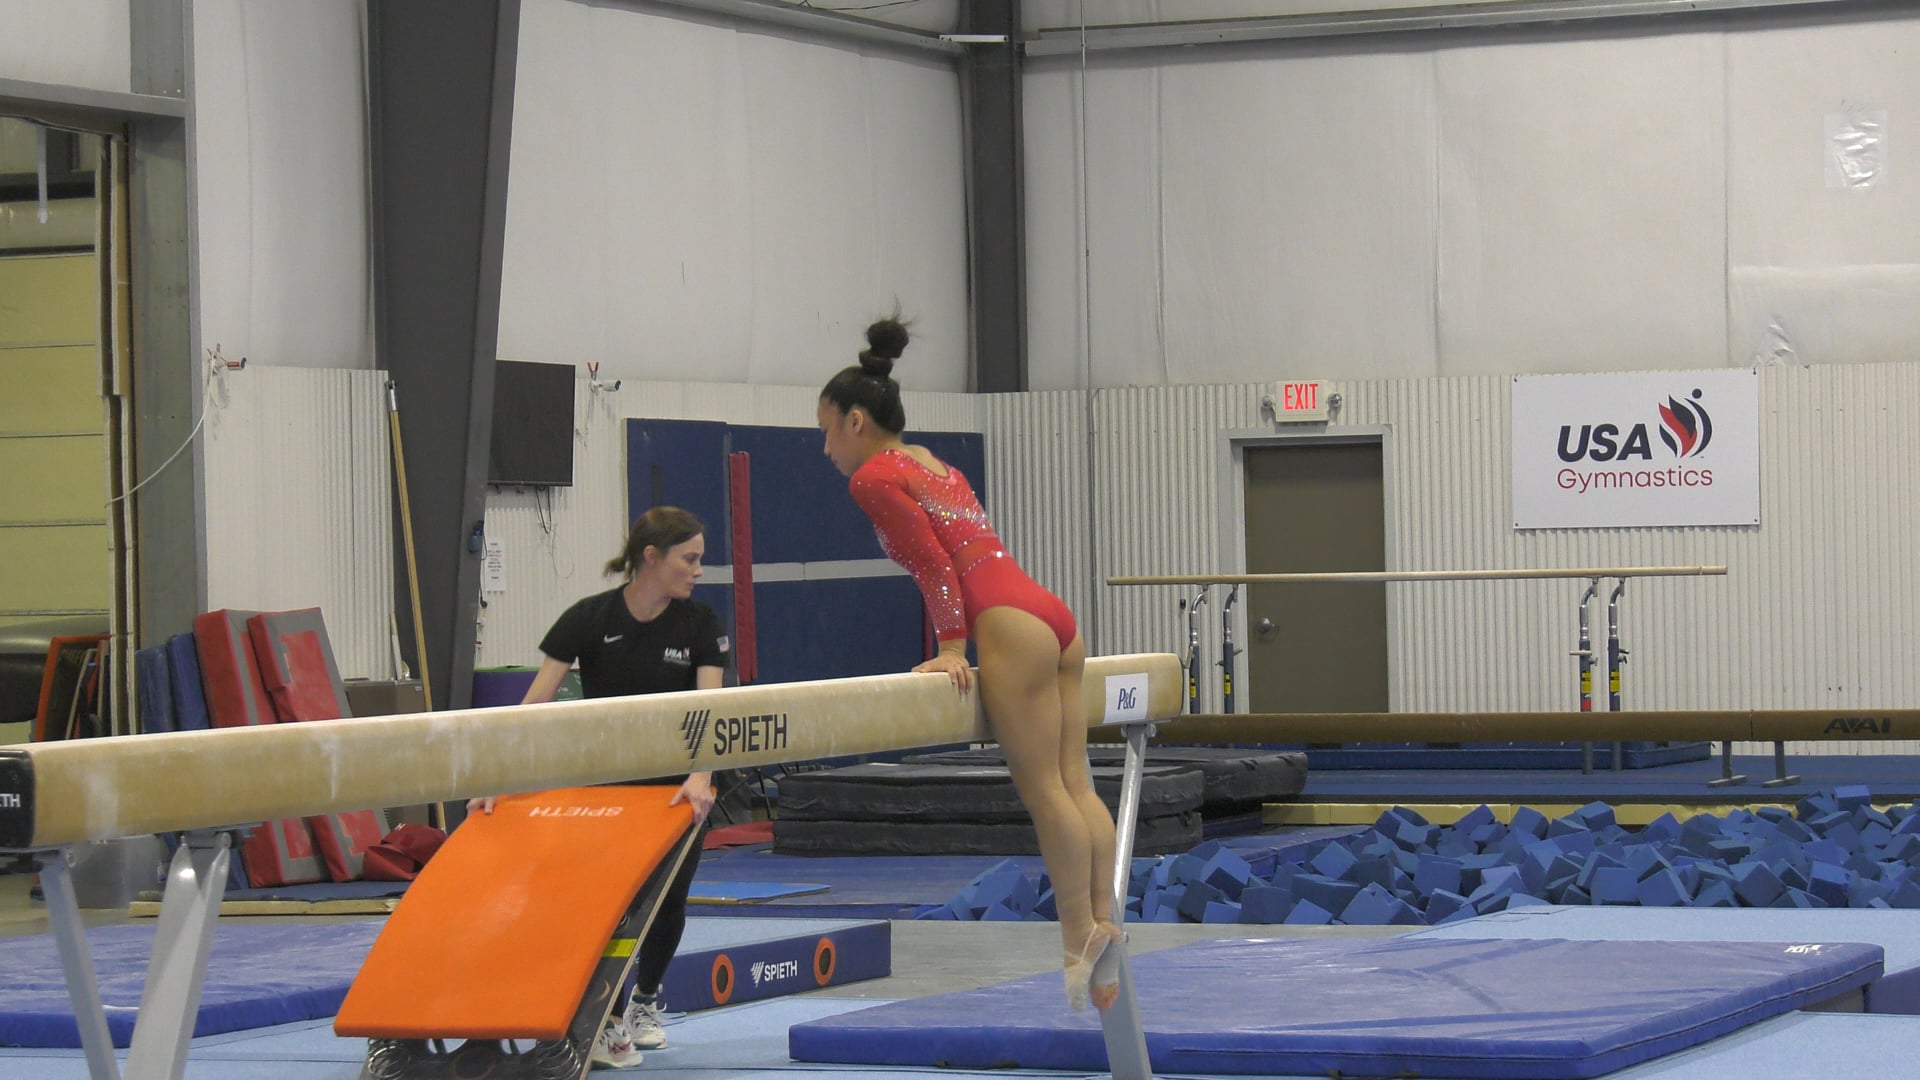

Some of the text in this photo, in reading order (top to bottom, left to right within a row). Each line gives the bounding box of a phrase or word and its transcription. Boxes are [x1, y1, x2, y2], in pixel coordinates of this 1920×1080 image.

[1284, 383, 1318, 410] EXIT
[1557, 423, 1652, 463] USA
[1557, 465, 1713, 494] Gymnastics
[1117, 686, 1137, 710] P&G
[713, 713, 787, 756] SPIETH
[529, 806, 624, 817] SPIETH
[764, 960, 798, 982] SPIETH
